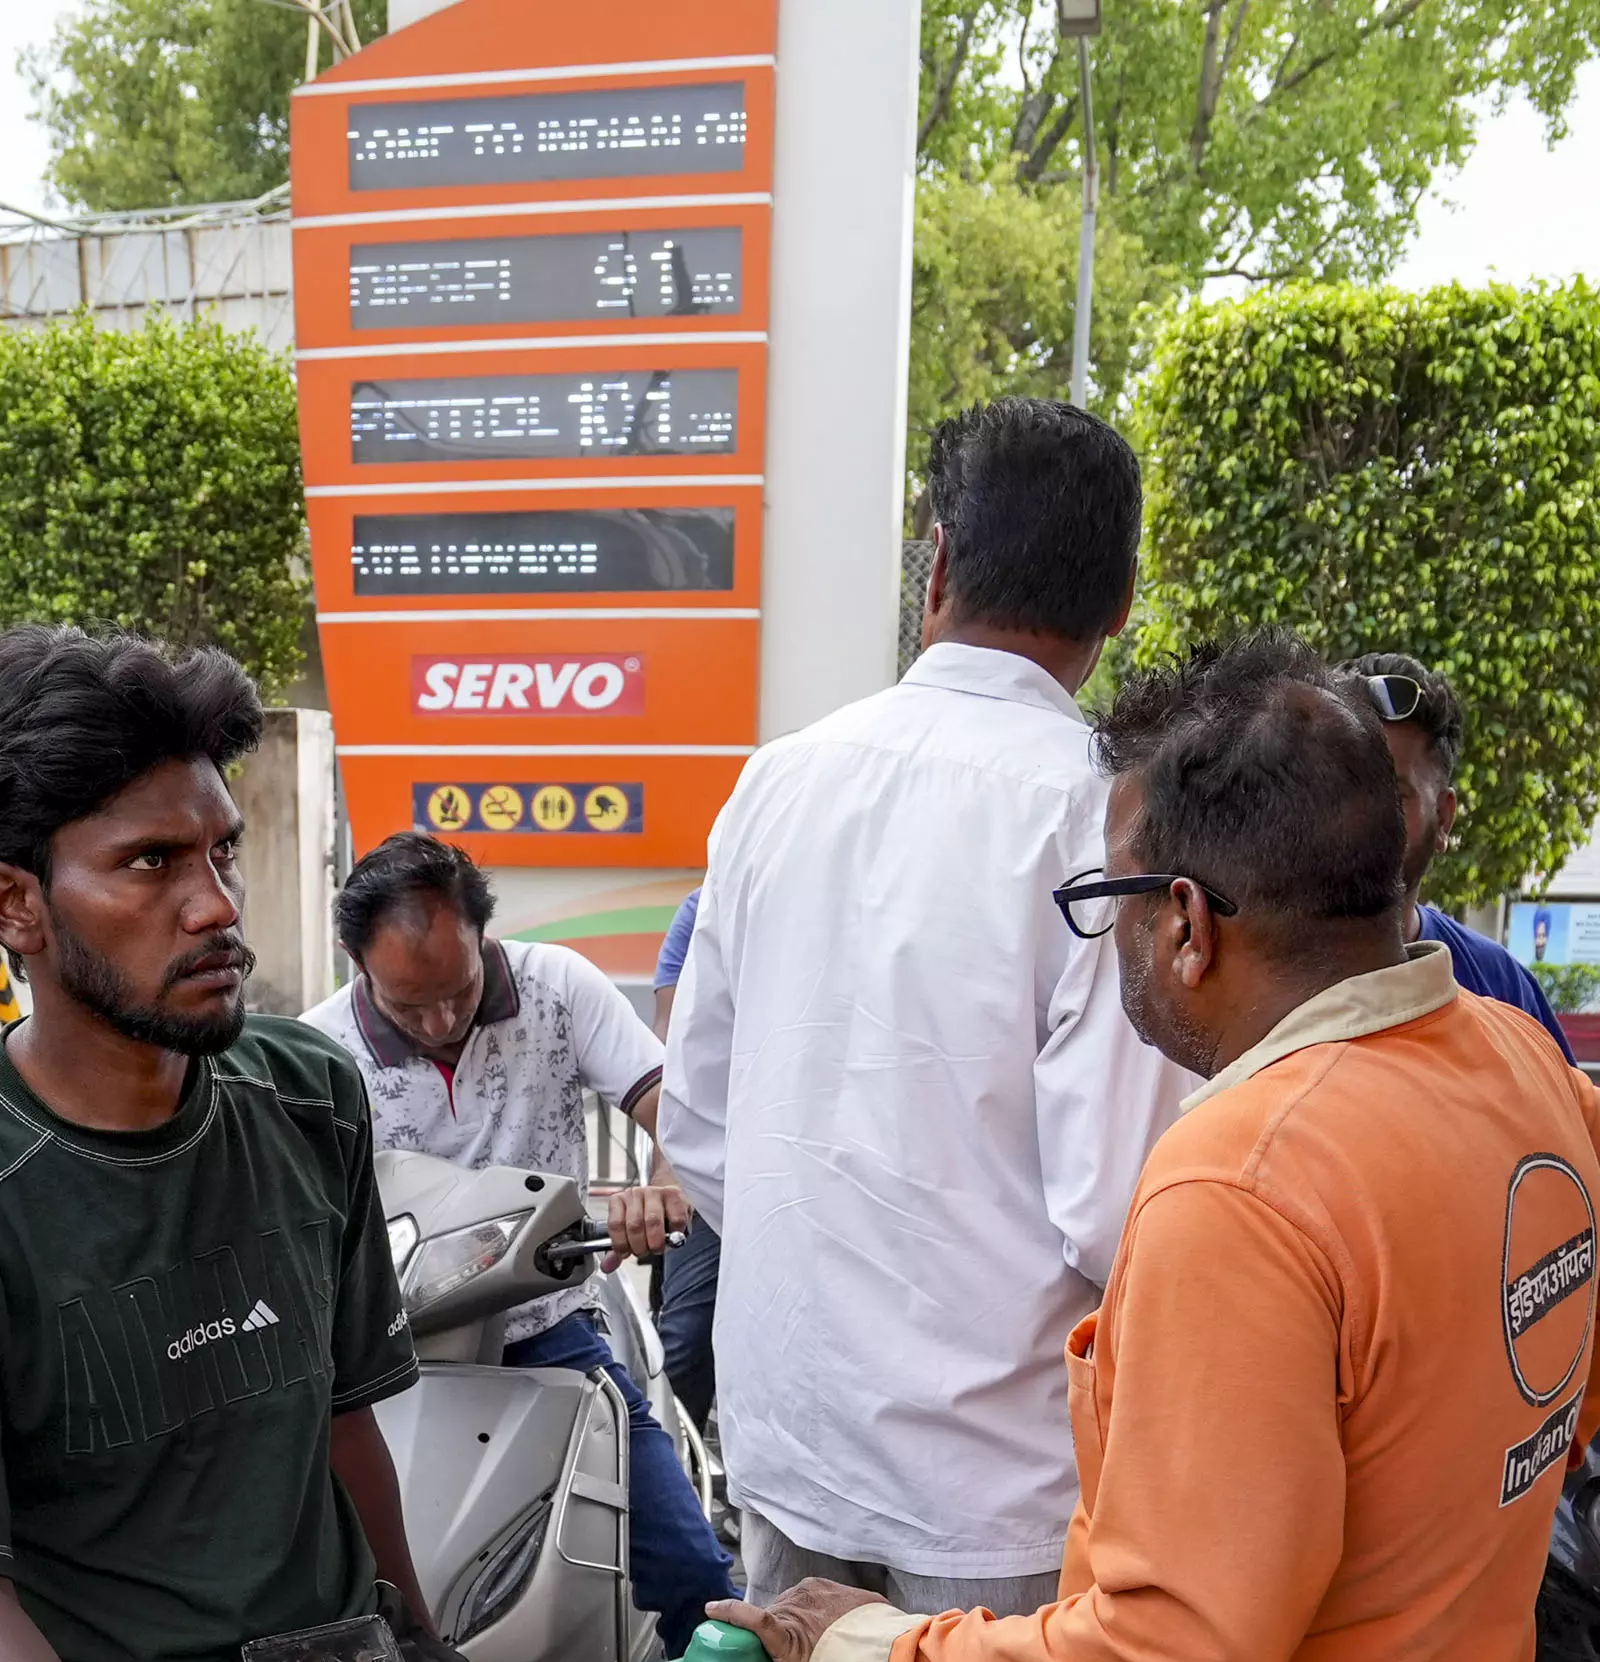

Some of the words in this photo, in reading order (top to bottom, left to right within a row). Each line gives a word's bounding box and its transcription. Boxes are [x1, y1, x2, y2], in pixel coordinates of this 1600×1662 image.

[418, 662, 624, 711] SERVO
[1508, 1237, 1592, 1334] इंडियनऑयल
[167, 1317, 237, 1360] adidas
[1507, 1406, 1579, 1495] IndianO
